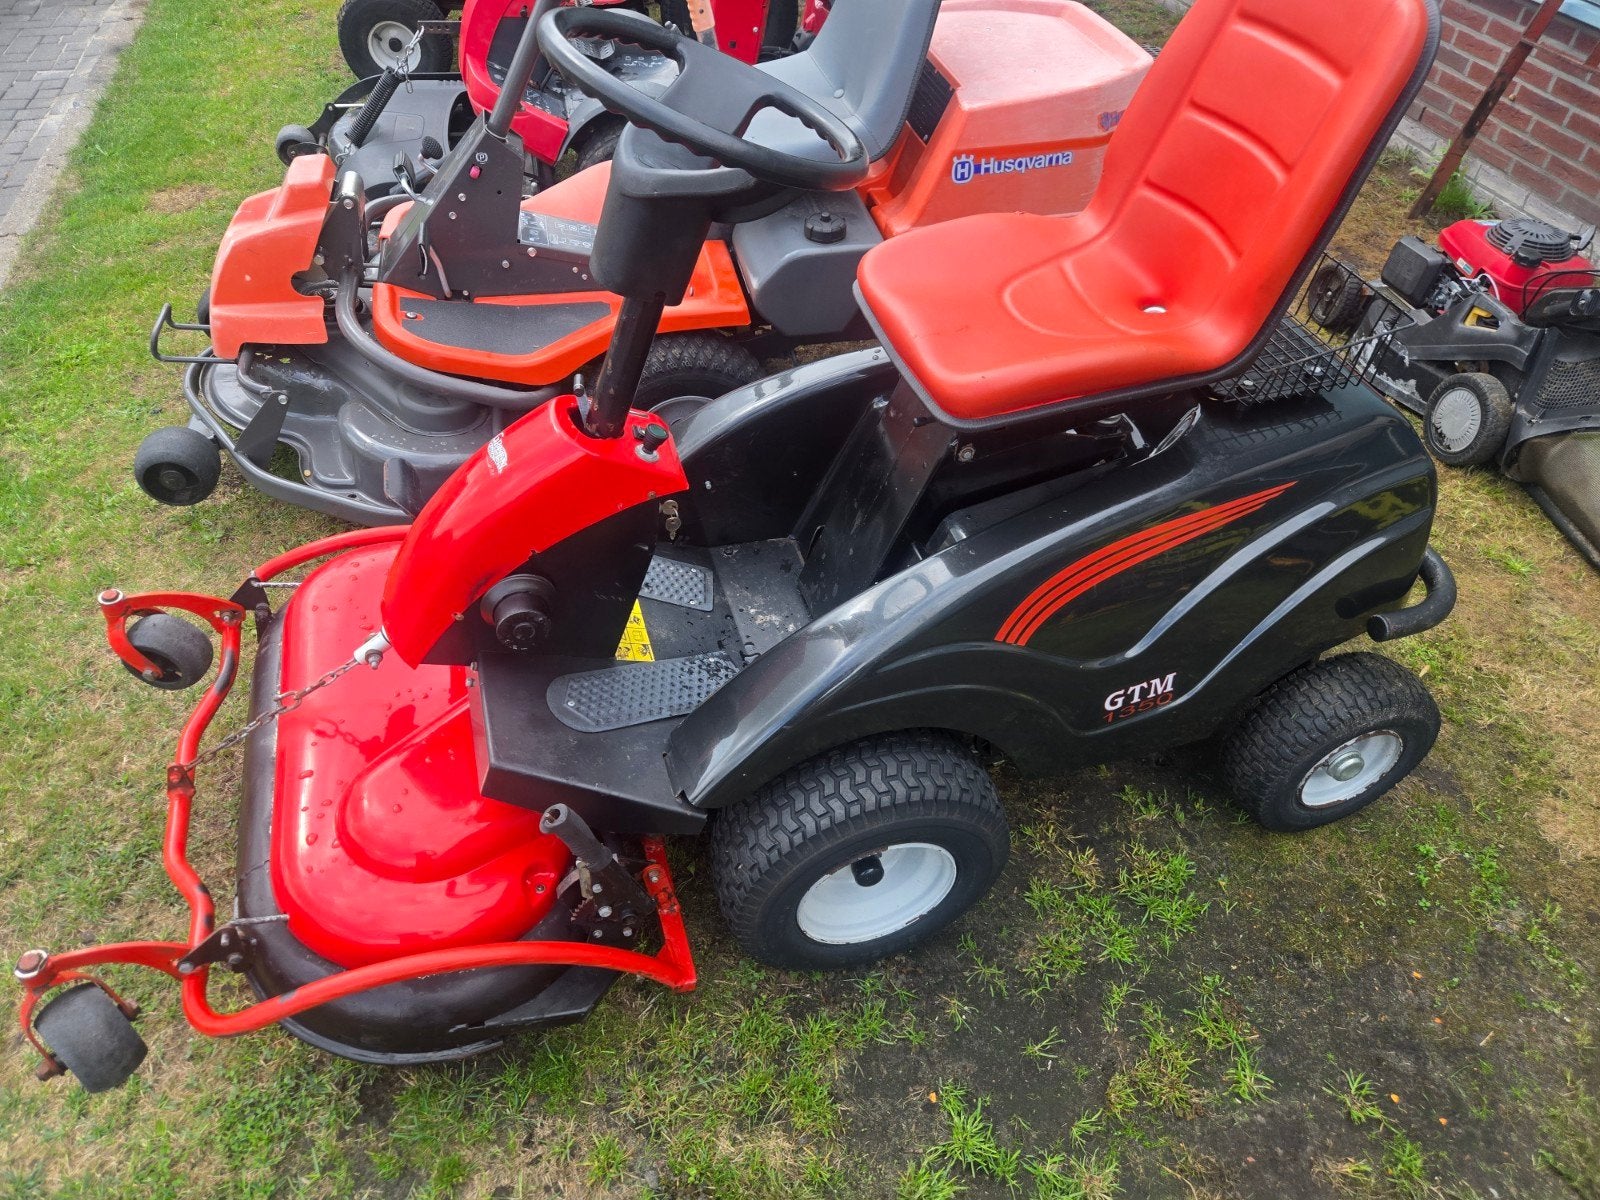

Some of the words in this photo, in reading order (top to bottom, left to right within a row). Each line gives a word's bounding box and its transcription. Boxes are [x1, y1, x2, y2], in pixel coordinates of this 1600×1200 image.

[980, 151, 1073, 175] Husqvarna
[1104, 672, 1177, 711] GTM
[1103, 692, 1173, 723] 1350
